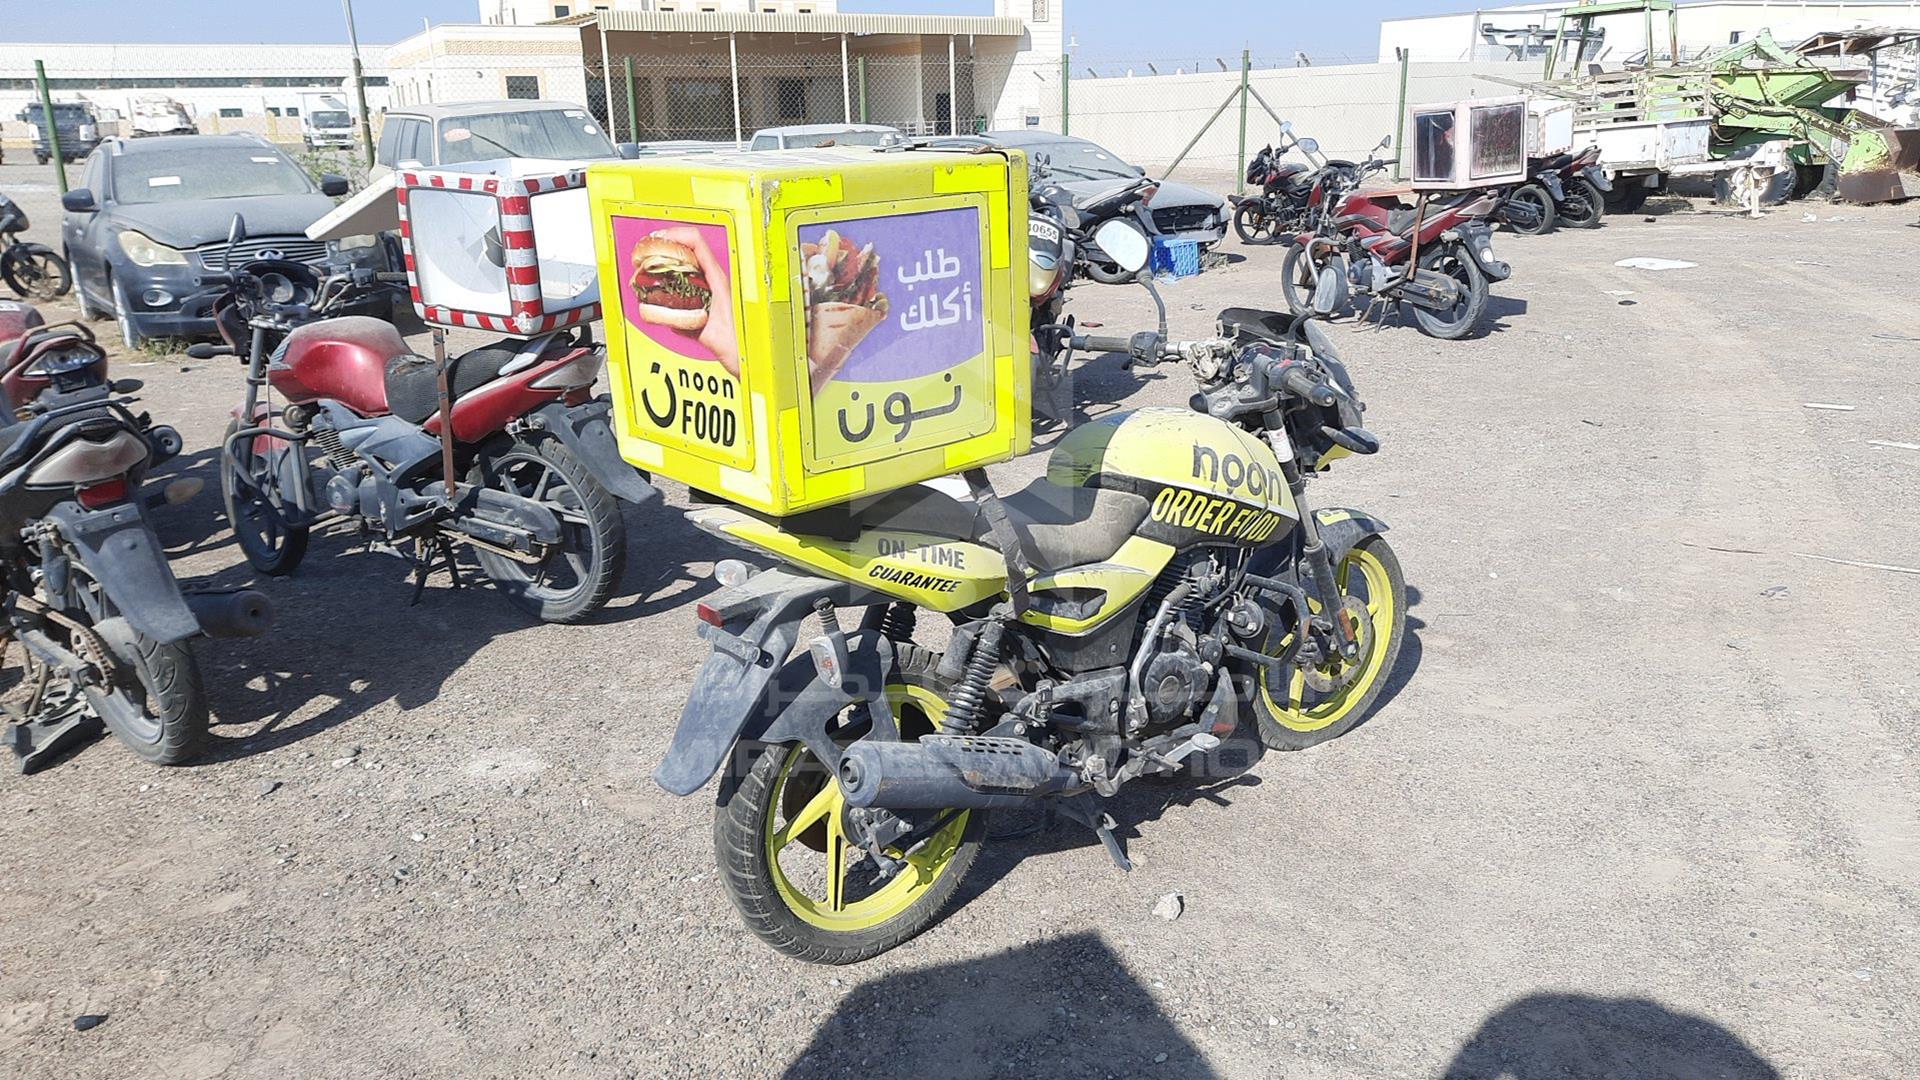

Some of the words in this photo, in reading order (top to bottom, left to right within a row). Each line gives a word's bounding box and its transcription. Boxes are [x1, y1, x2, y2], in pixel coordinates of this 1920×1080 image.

[1029, 223, 1059, 241] 0655
[898, 248, 961, 288] طلب
[900, 282, 973, 331] أكلك
[678, 368, 735, 400] noon
[682, 400, 736, 448] FOOD
[838, 372, 963, 443] نون
[1192, 443, 1284, 507] noon
[1152, 487, 1231, 535] ORDER
[1231, 506, 1280, 543] FOOD
[877, 537, 966, 570] ON-TIME
[867, 563, 962, 594] GUARANTEE
